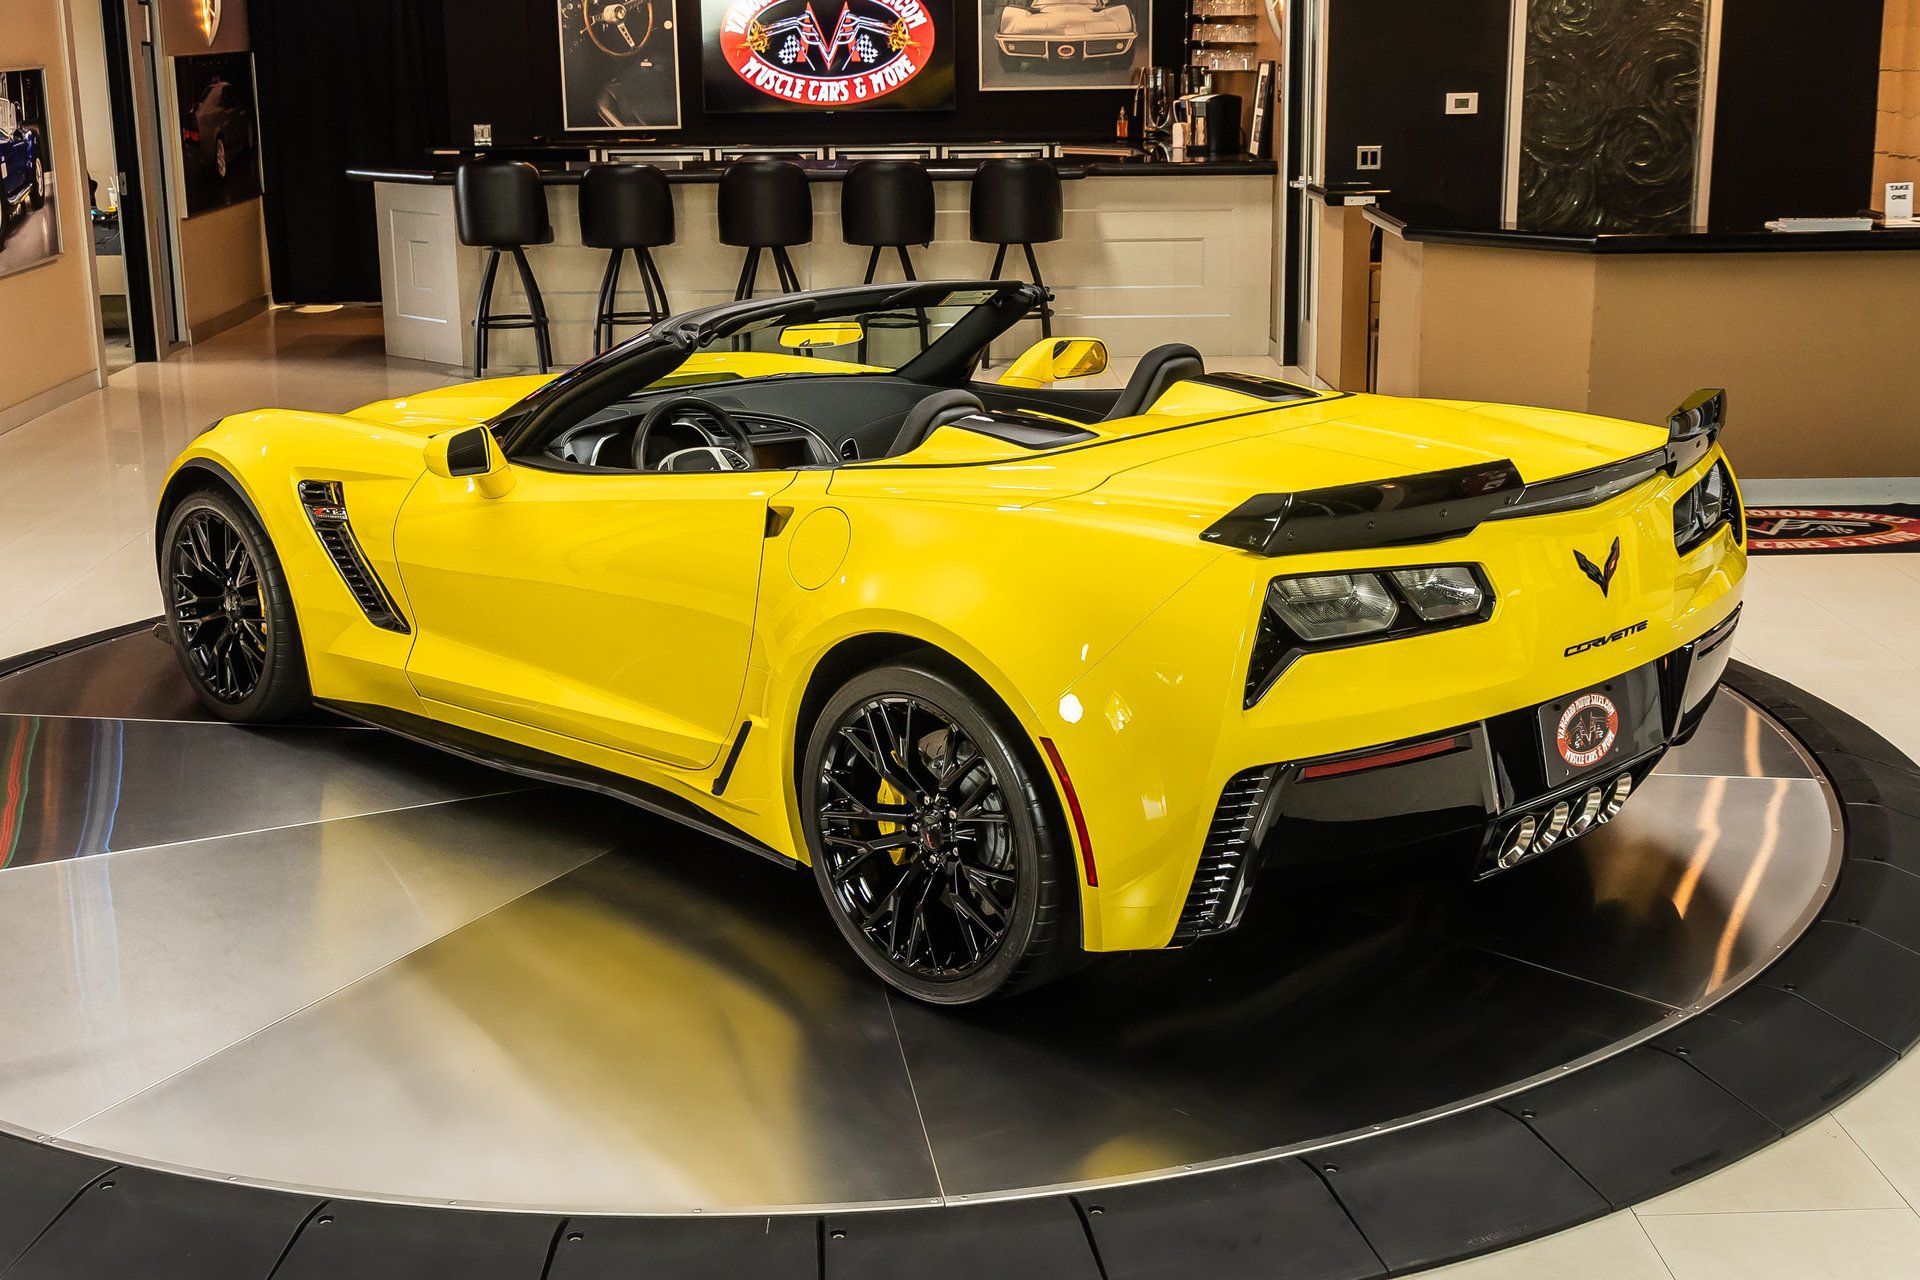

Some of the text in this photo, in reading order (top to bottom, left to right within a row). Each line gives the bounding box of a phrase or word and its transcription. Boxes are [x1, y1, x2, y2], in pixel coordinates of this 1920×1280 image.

[740, 54, 917, 102] MUSCLE CARS & MORE
[1745, 509, 1818, 518] OTOR
[1755, 541, 1830, 549] CARS
[1563, 619, 1648, 657] CORVETTE
[1564, 749, 1585, 764] MUSCLE
[1585, 750, 1598, 763] CARS
